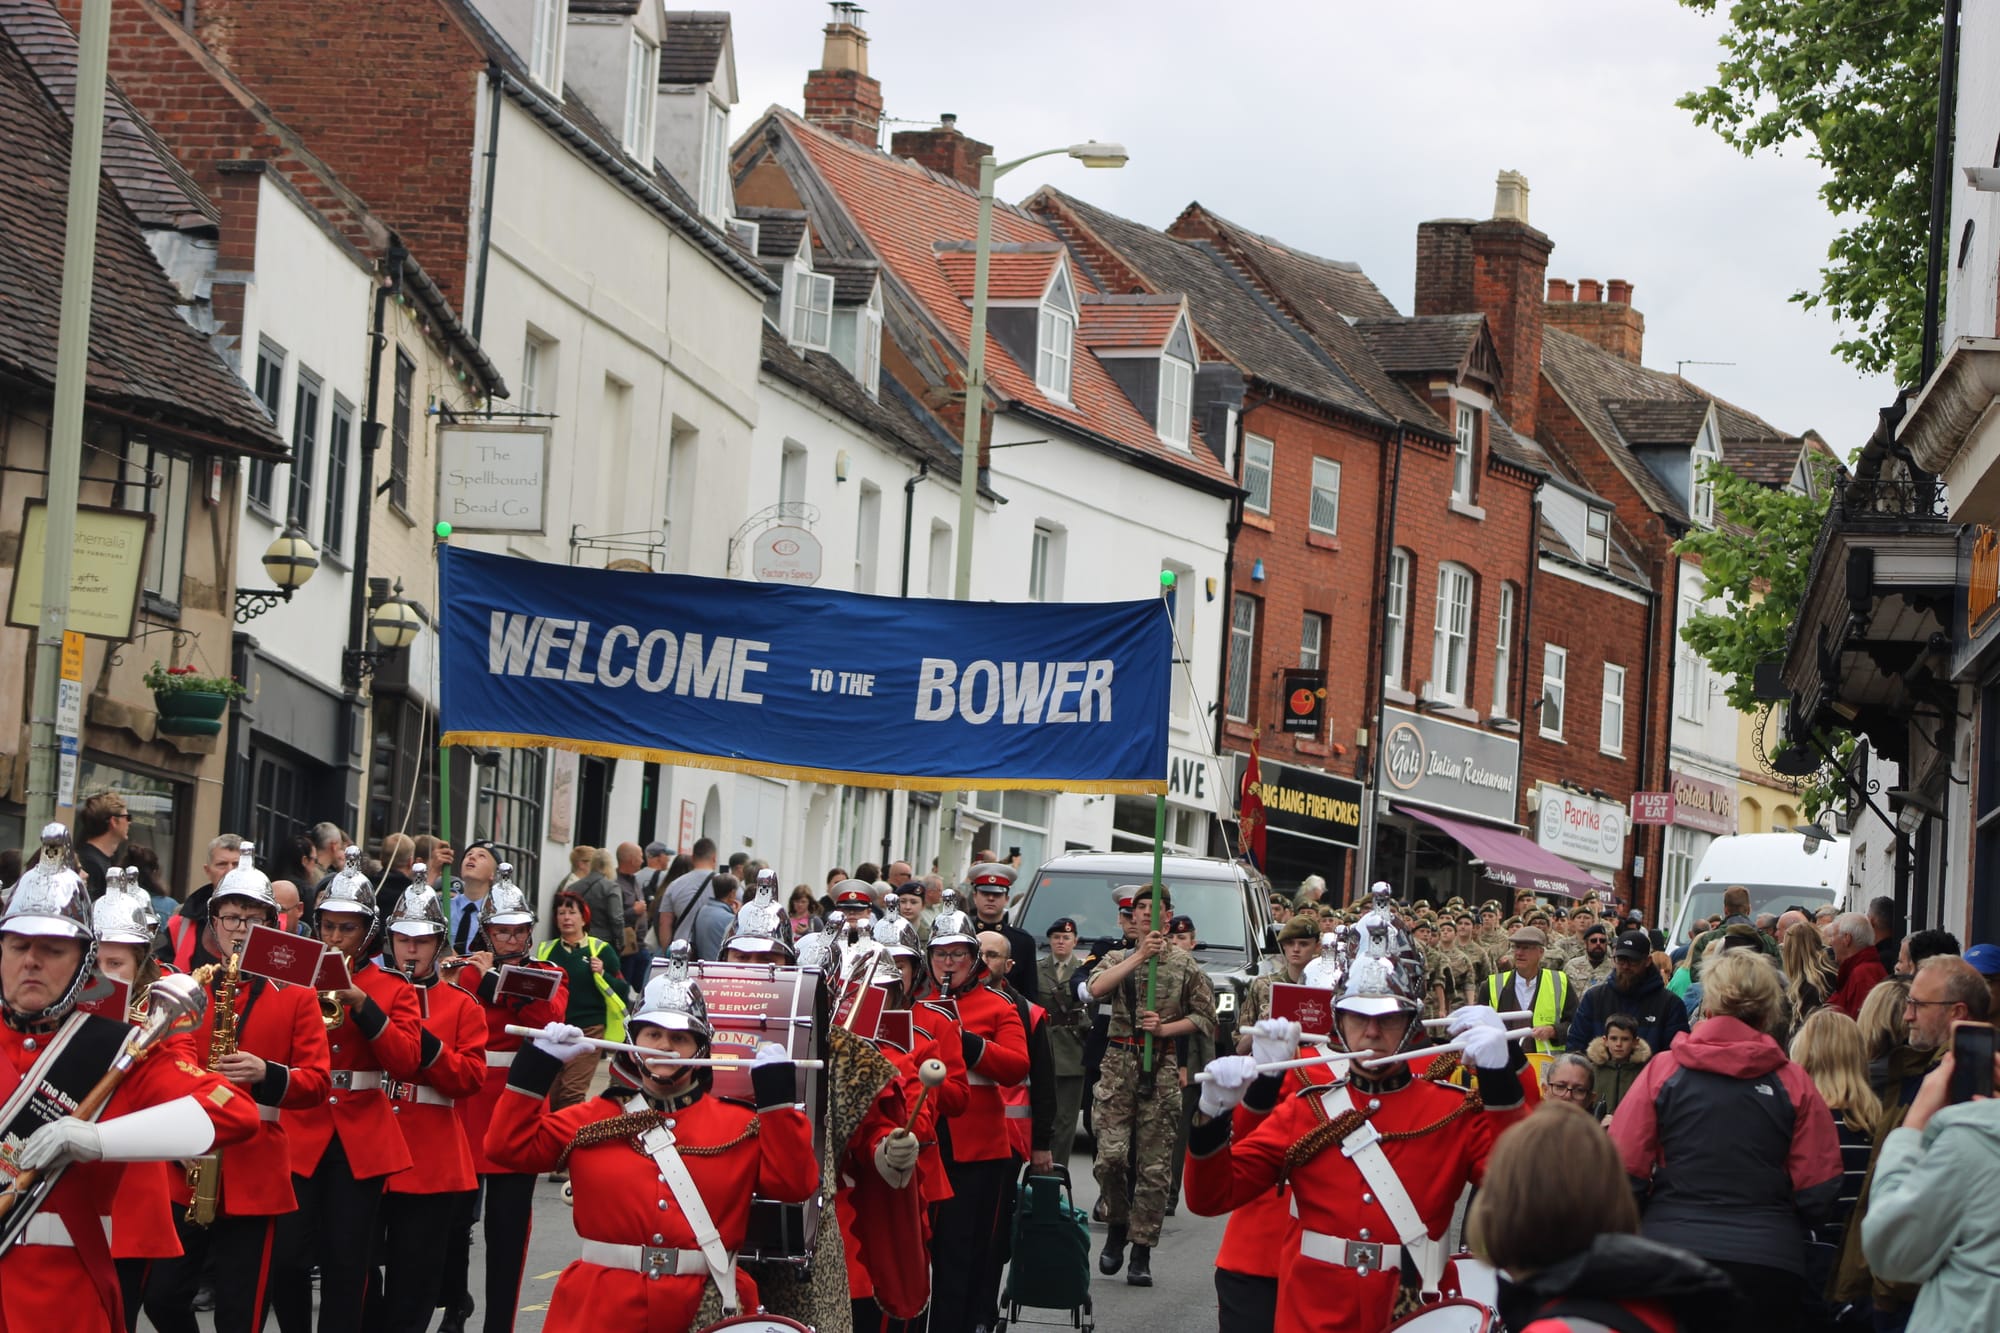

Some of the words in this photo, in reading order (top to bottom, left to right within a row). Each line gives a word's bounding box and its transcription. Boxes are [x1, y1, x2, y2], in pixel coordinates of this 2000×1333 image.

[476, 445, 511, 462] The
[447, 469, 538, 489] Spellbound
[453, 497, 498, 514] Bead
[502, 499, 529, 517] Co
[489, 610, 770, 705] WELCOME
[810, 668, 833, 692] TO
[839, 671, 875, 697] THE
[914, 657, 1114, 725] BOWER
[1392, 745, 1420, 780] Goli
[1426, 750, 1461, 779] Italian
[1462, 756, 1513, 792] Restaurant
[1262, 782, 1278, 809] BIG
[1279, 789, 1305, 816] BANG
[1305, 793, 1360, 827] FIREWORKS
[1638, 795, 1669, 806] JUST
[1674, 779, 1711, 812] Golden
[1564, 800, 1600, 831] Paprika
[1645, 807, 1668, 817] EAT
[731, 978, 762, 986] BAND
[720, 990, 779, 999] MIDLANDS
[718, 1003, 768, 1011] SERVICE
[40, 1079, 60, 1098] The
[58, 1091, 79, 1112] Ban
